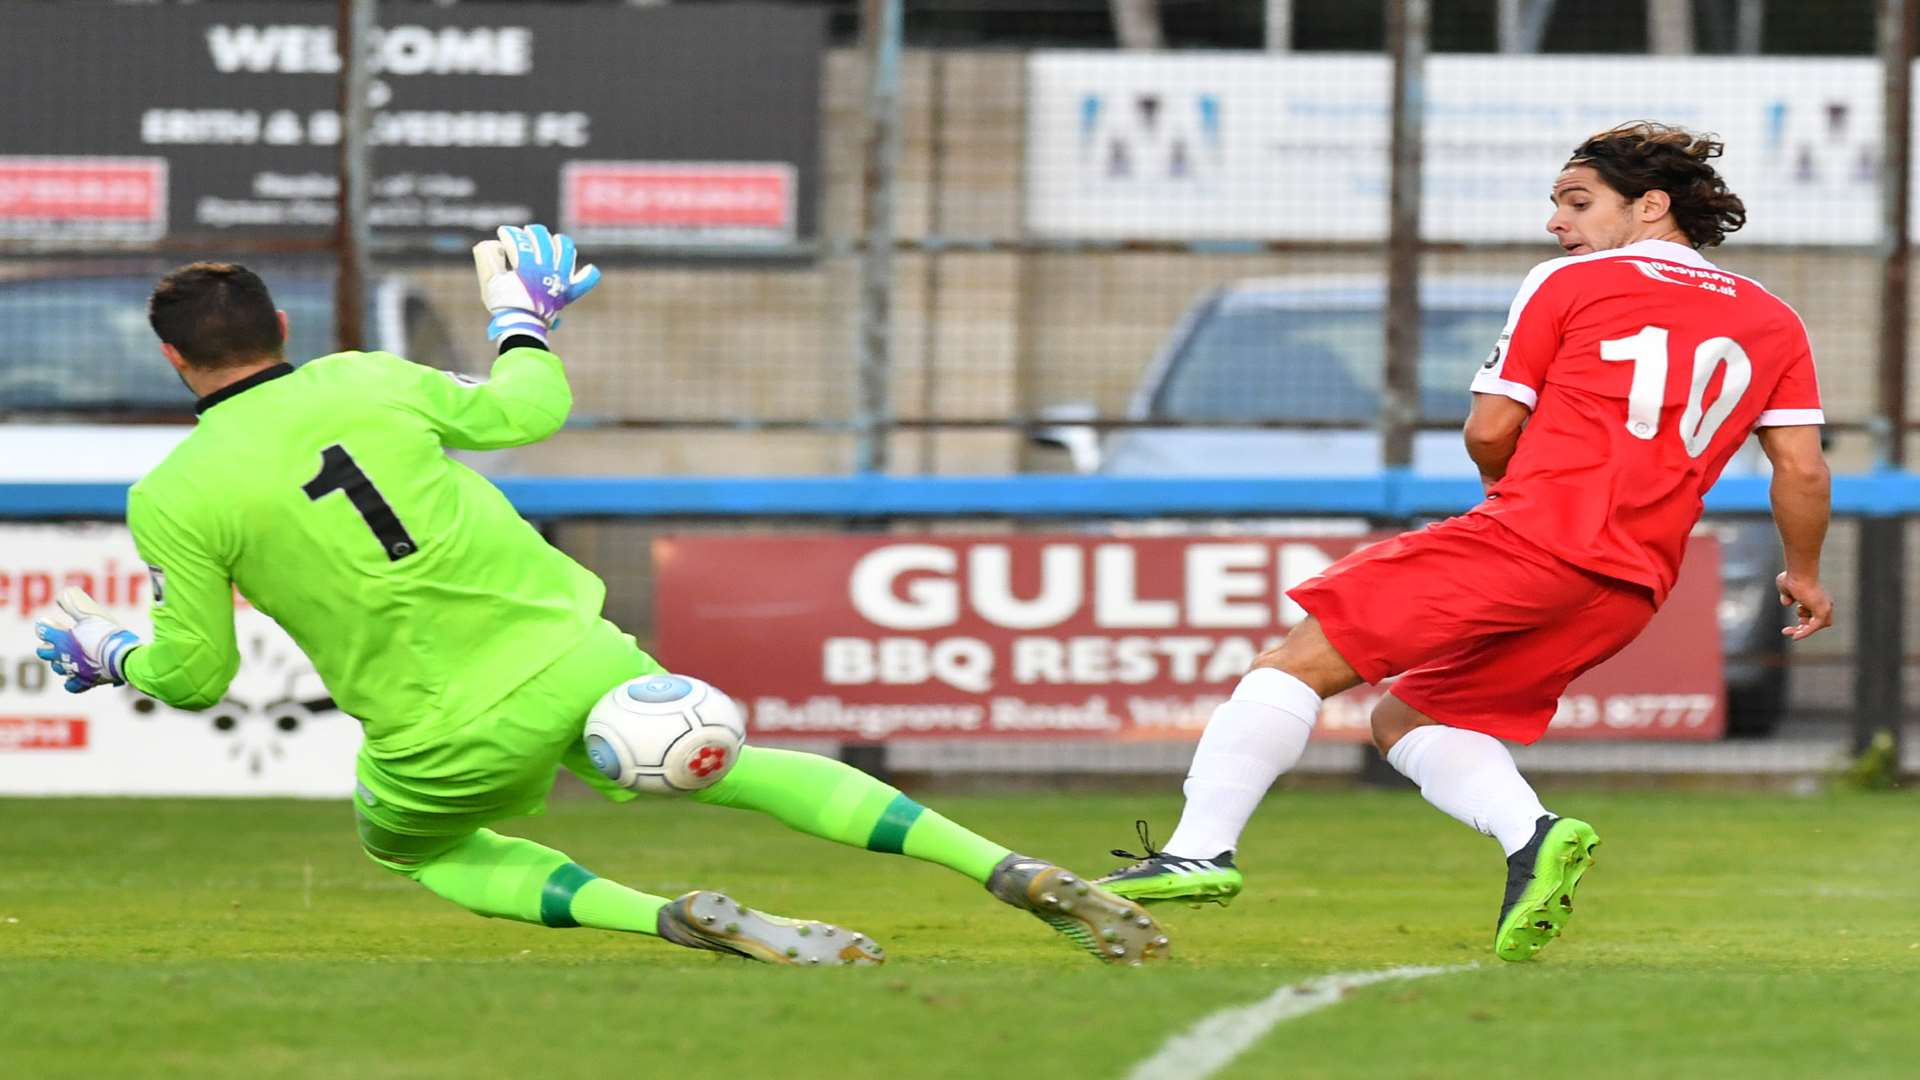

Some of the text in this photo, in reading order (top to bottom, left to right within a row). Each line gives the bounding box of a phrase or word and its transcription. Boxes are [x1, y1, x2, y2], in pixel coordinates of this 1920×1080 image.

[308, 110, 526, 147] BVEDERE
[1600, 325, 1752, 459] 10
[301, 443, 419, 563] 1
[822, 636, 1286, 693] BBQ RESTA
